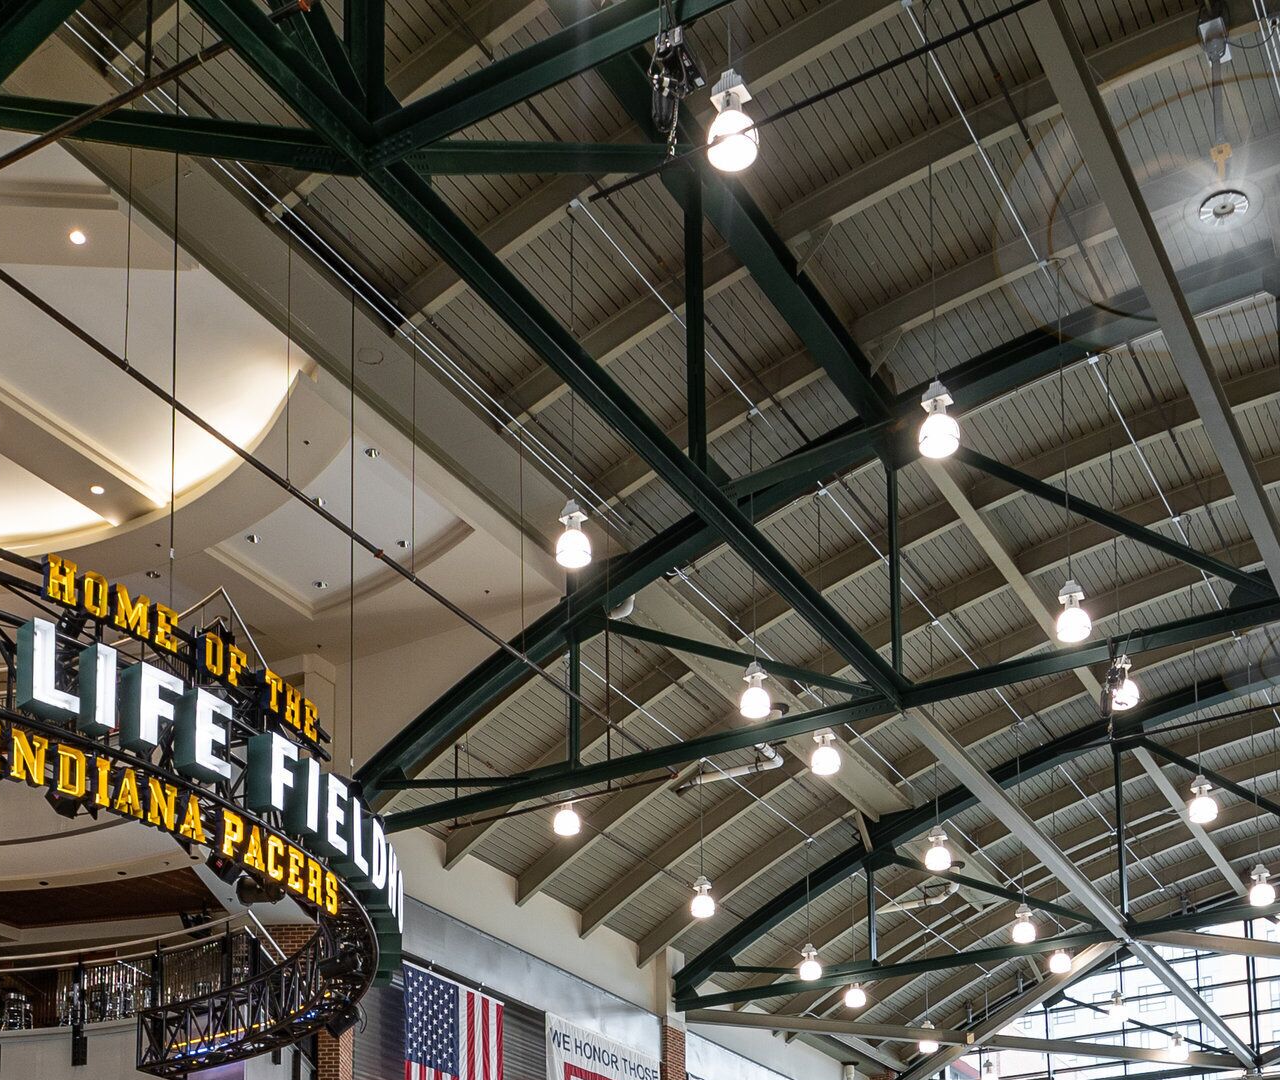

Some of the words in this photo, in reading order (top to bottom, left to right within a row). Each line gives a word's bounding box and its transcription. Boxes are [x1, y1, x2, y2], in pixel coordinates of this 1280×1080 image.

[29, 615, 234, 782] LIFE
[43, 553, 179, 652] HOME
[200, 630, 248, 688] OF
[260, 668, 320, 743] THE
[220, 808, 340, 916] PACERS
[549, 1027, 571, 1053] WE
[574, 1037, 620, 1072] HONOR
